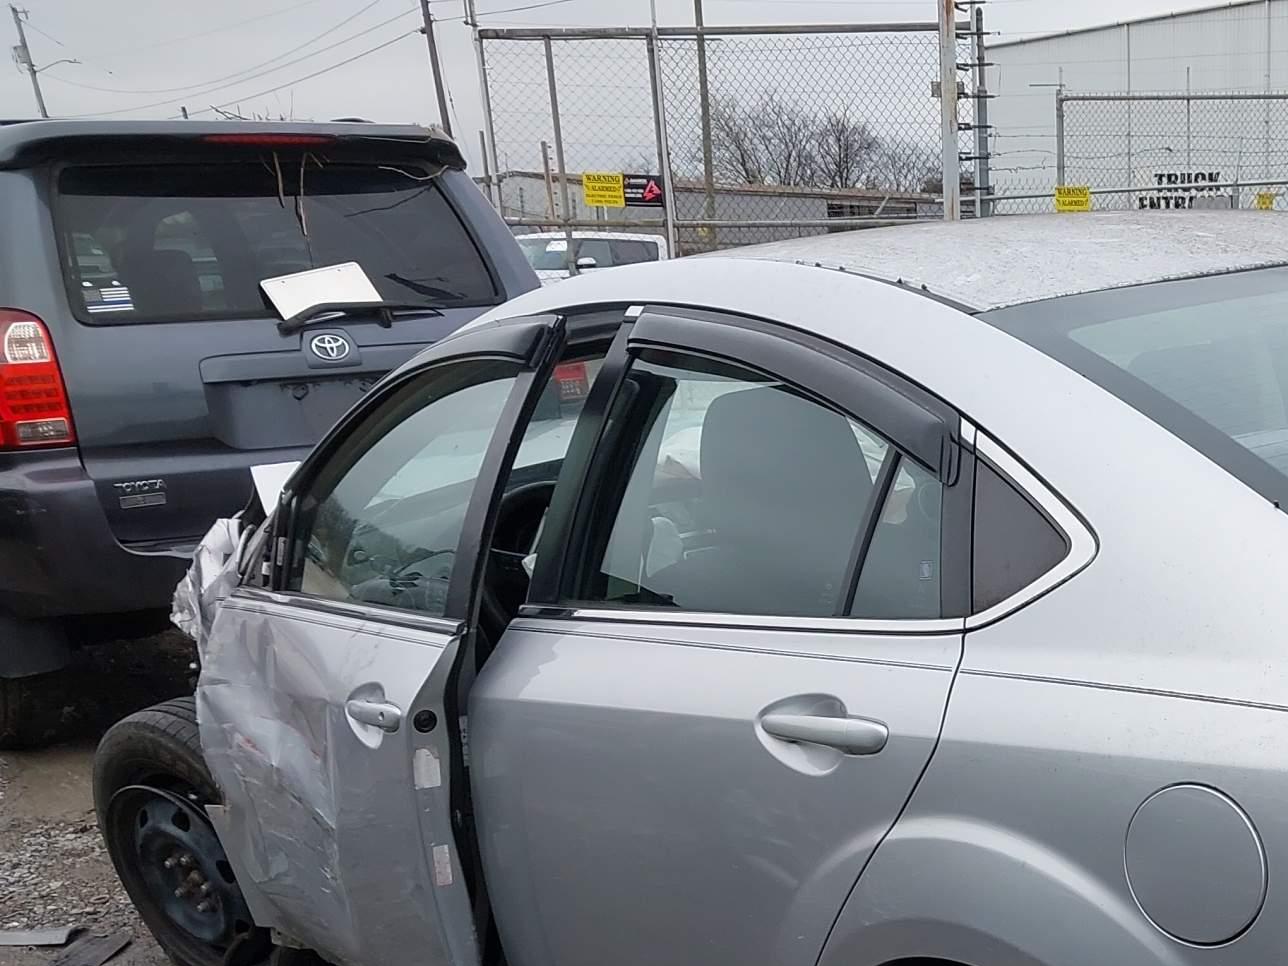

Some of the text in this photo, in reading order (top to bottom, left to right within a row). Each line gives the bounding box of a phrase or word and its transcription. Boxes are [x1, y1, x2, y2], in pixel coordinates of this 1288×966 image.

[1154, 171, 1221, 193] TRUCK
[1056, 187, 1088, 196] WARNING
[113, 479, 167, 492] TOYOTA
